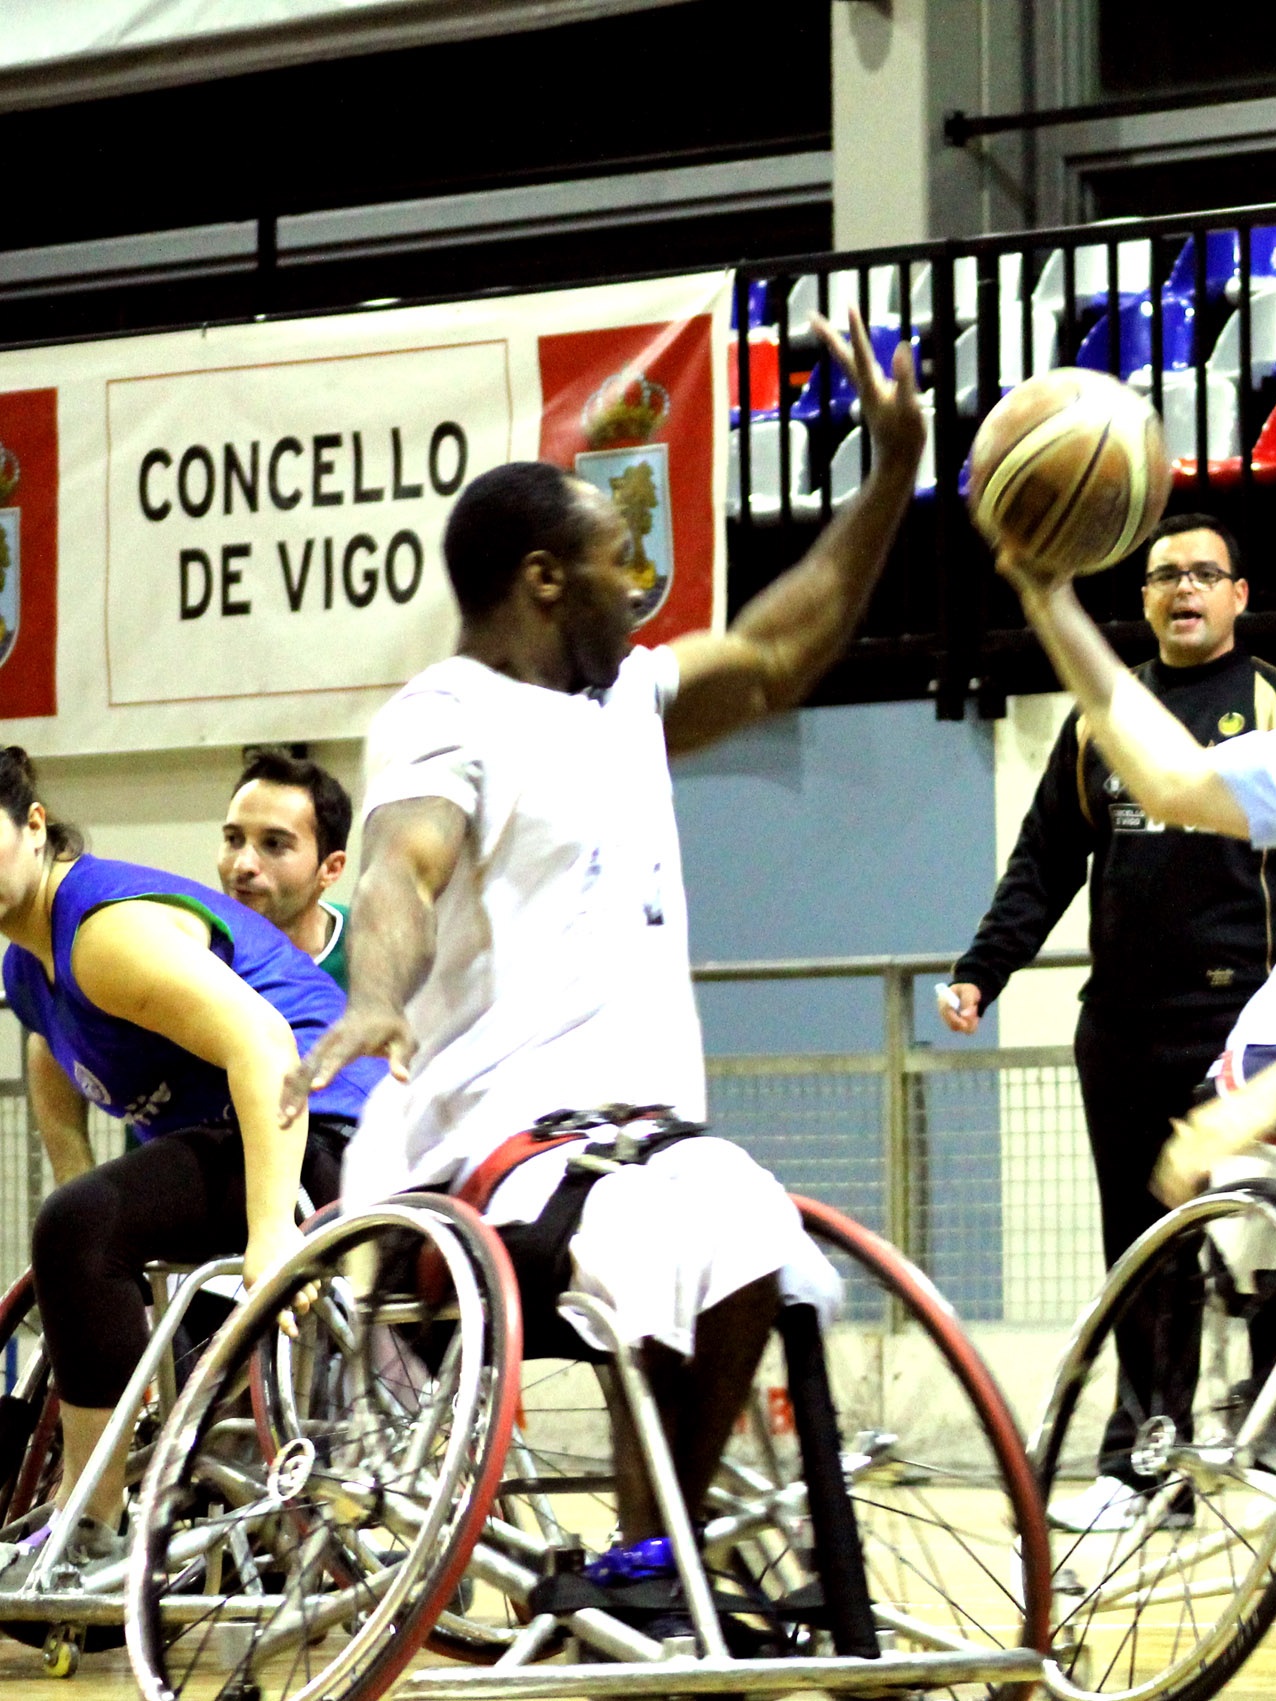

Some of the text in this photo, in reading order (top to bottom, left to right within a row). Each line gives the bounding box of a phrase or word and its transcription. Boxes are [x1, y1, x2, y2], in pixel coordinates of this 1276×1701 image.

[138, 420, 468, 523] CONCELLO
[179, 529, 424, 620] DE VIGO
